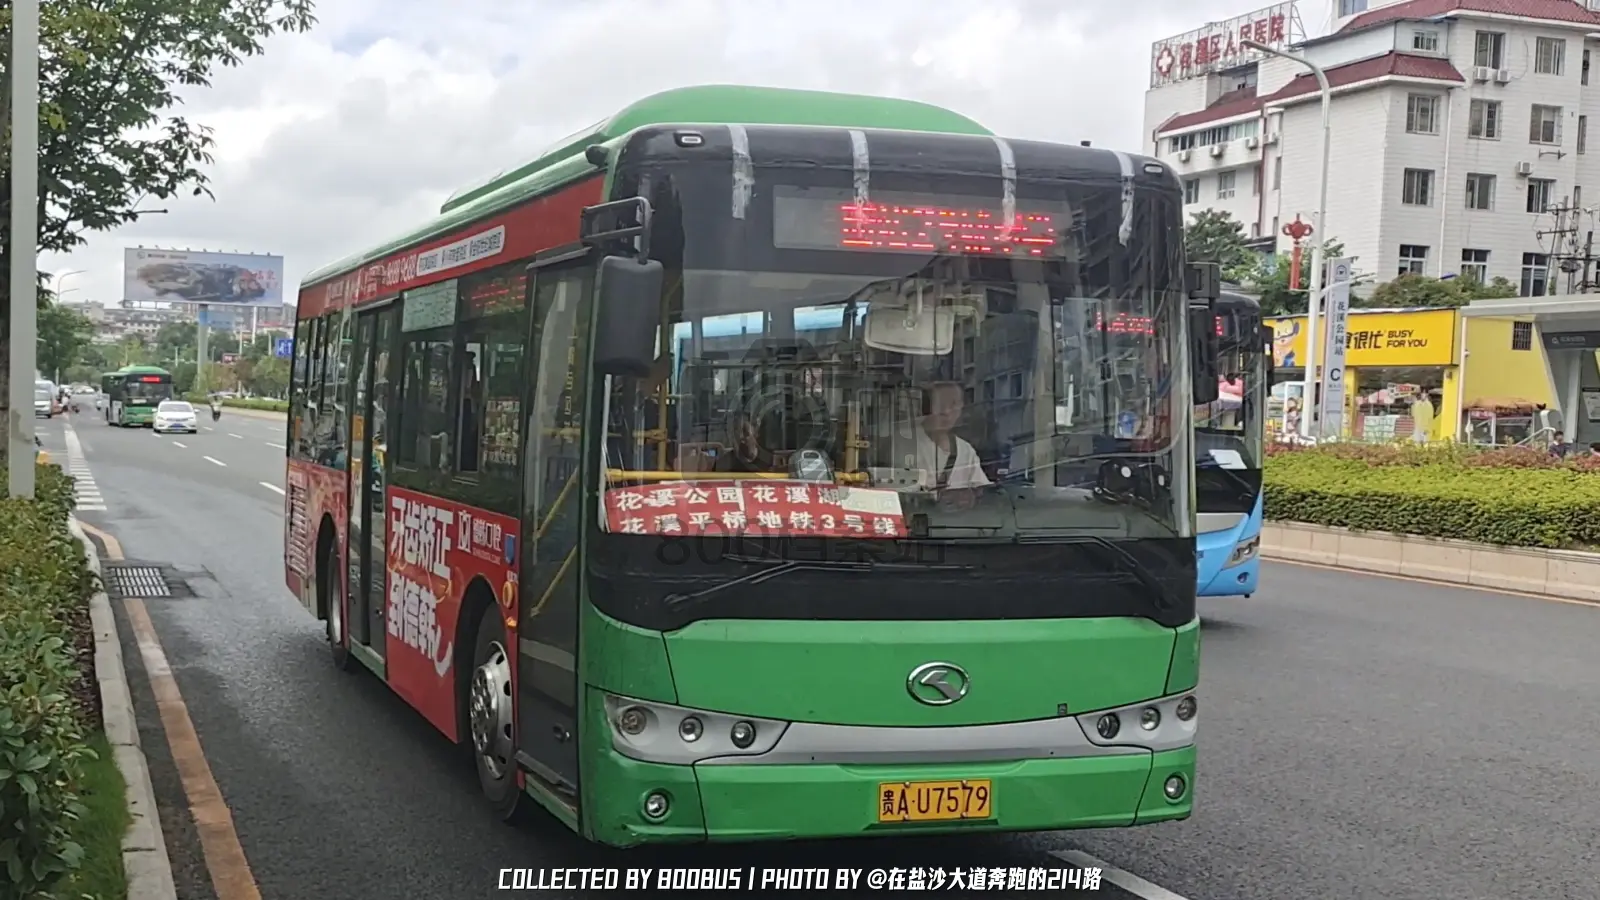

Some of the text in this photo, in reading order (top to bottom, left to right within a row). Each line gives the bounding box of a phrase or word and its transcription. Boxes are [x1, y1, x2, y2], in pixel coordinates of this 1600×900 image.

[1388, 330, 1414, 339] BUSY
[1387, 339, 1428, 348] FOR YOU
[1330, 368, 1341, 381] C
[390, 496, 453, 580] 牙齿矫正
